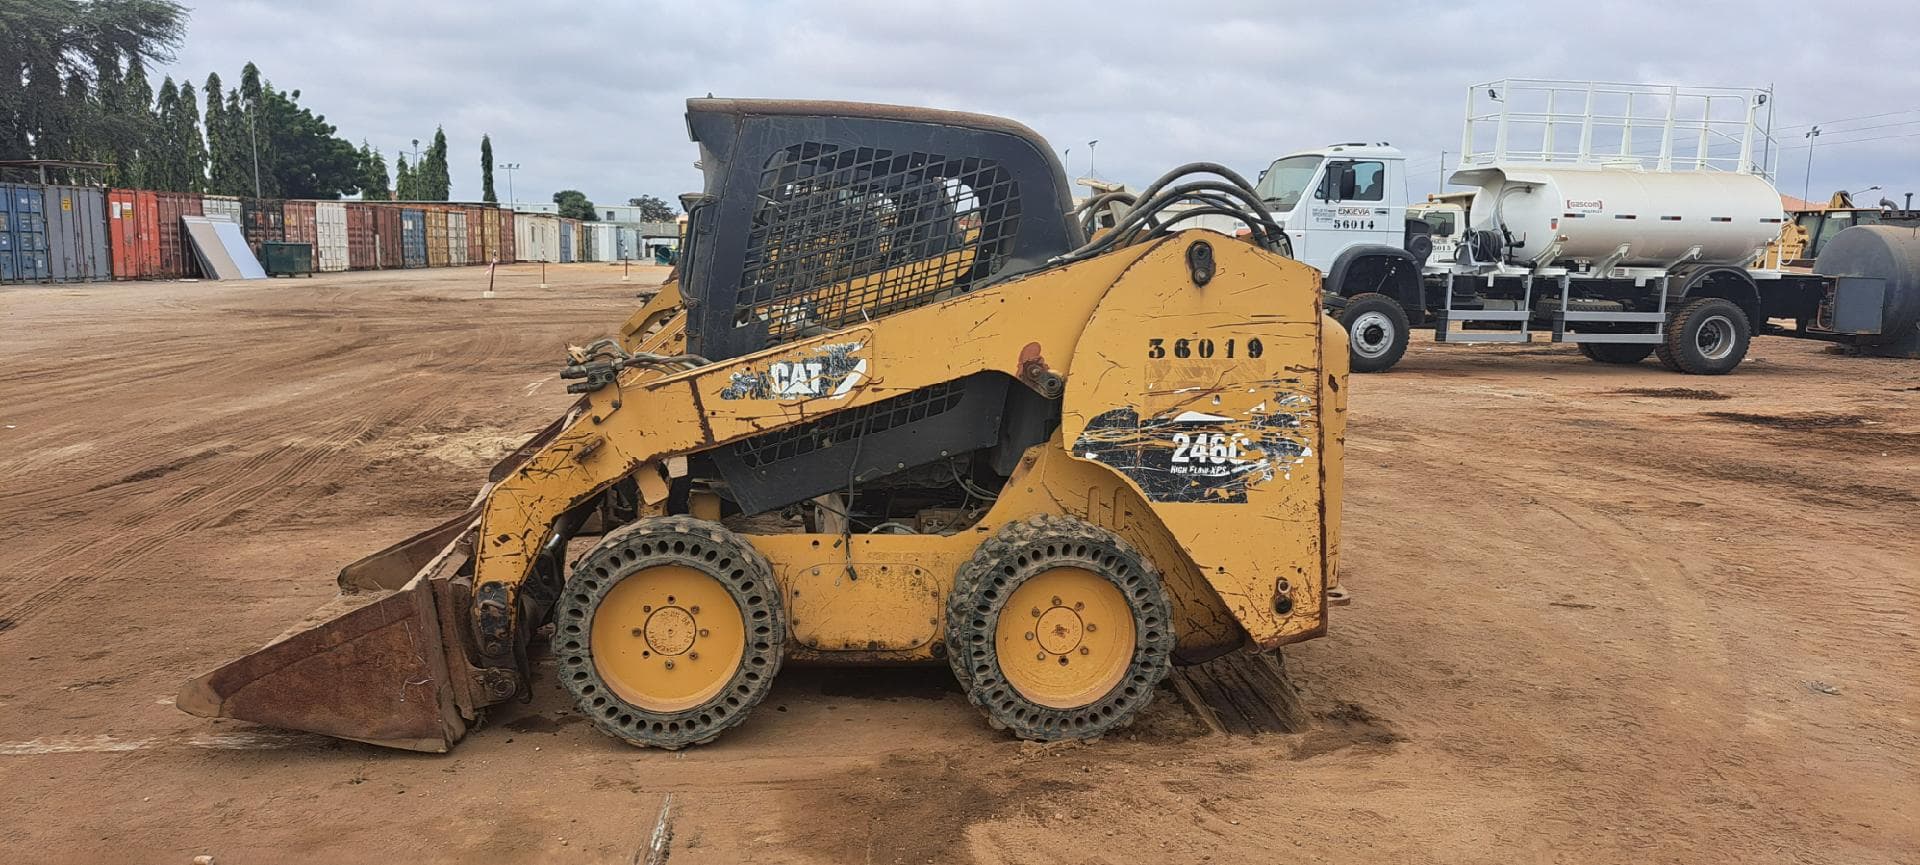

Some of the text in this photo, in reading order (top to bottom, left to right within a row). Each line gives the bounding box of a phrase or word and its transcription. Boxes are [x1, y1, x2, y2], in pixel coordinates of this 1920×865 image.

[1334, 219, 1374, 230] 56014
[770, 362, 822, 394] CAT
[1171, 432, 1249, 464] 246C
[1170, 465, 1188, 474] HIGH
